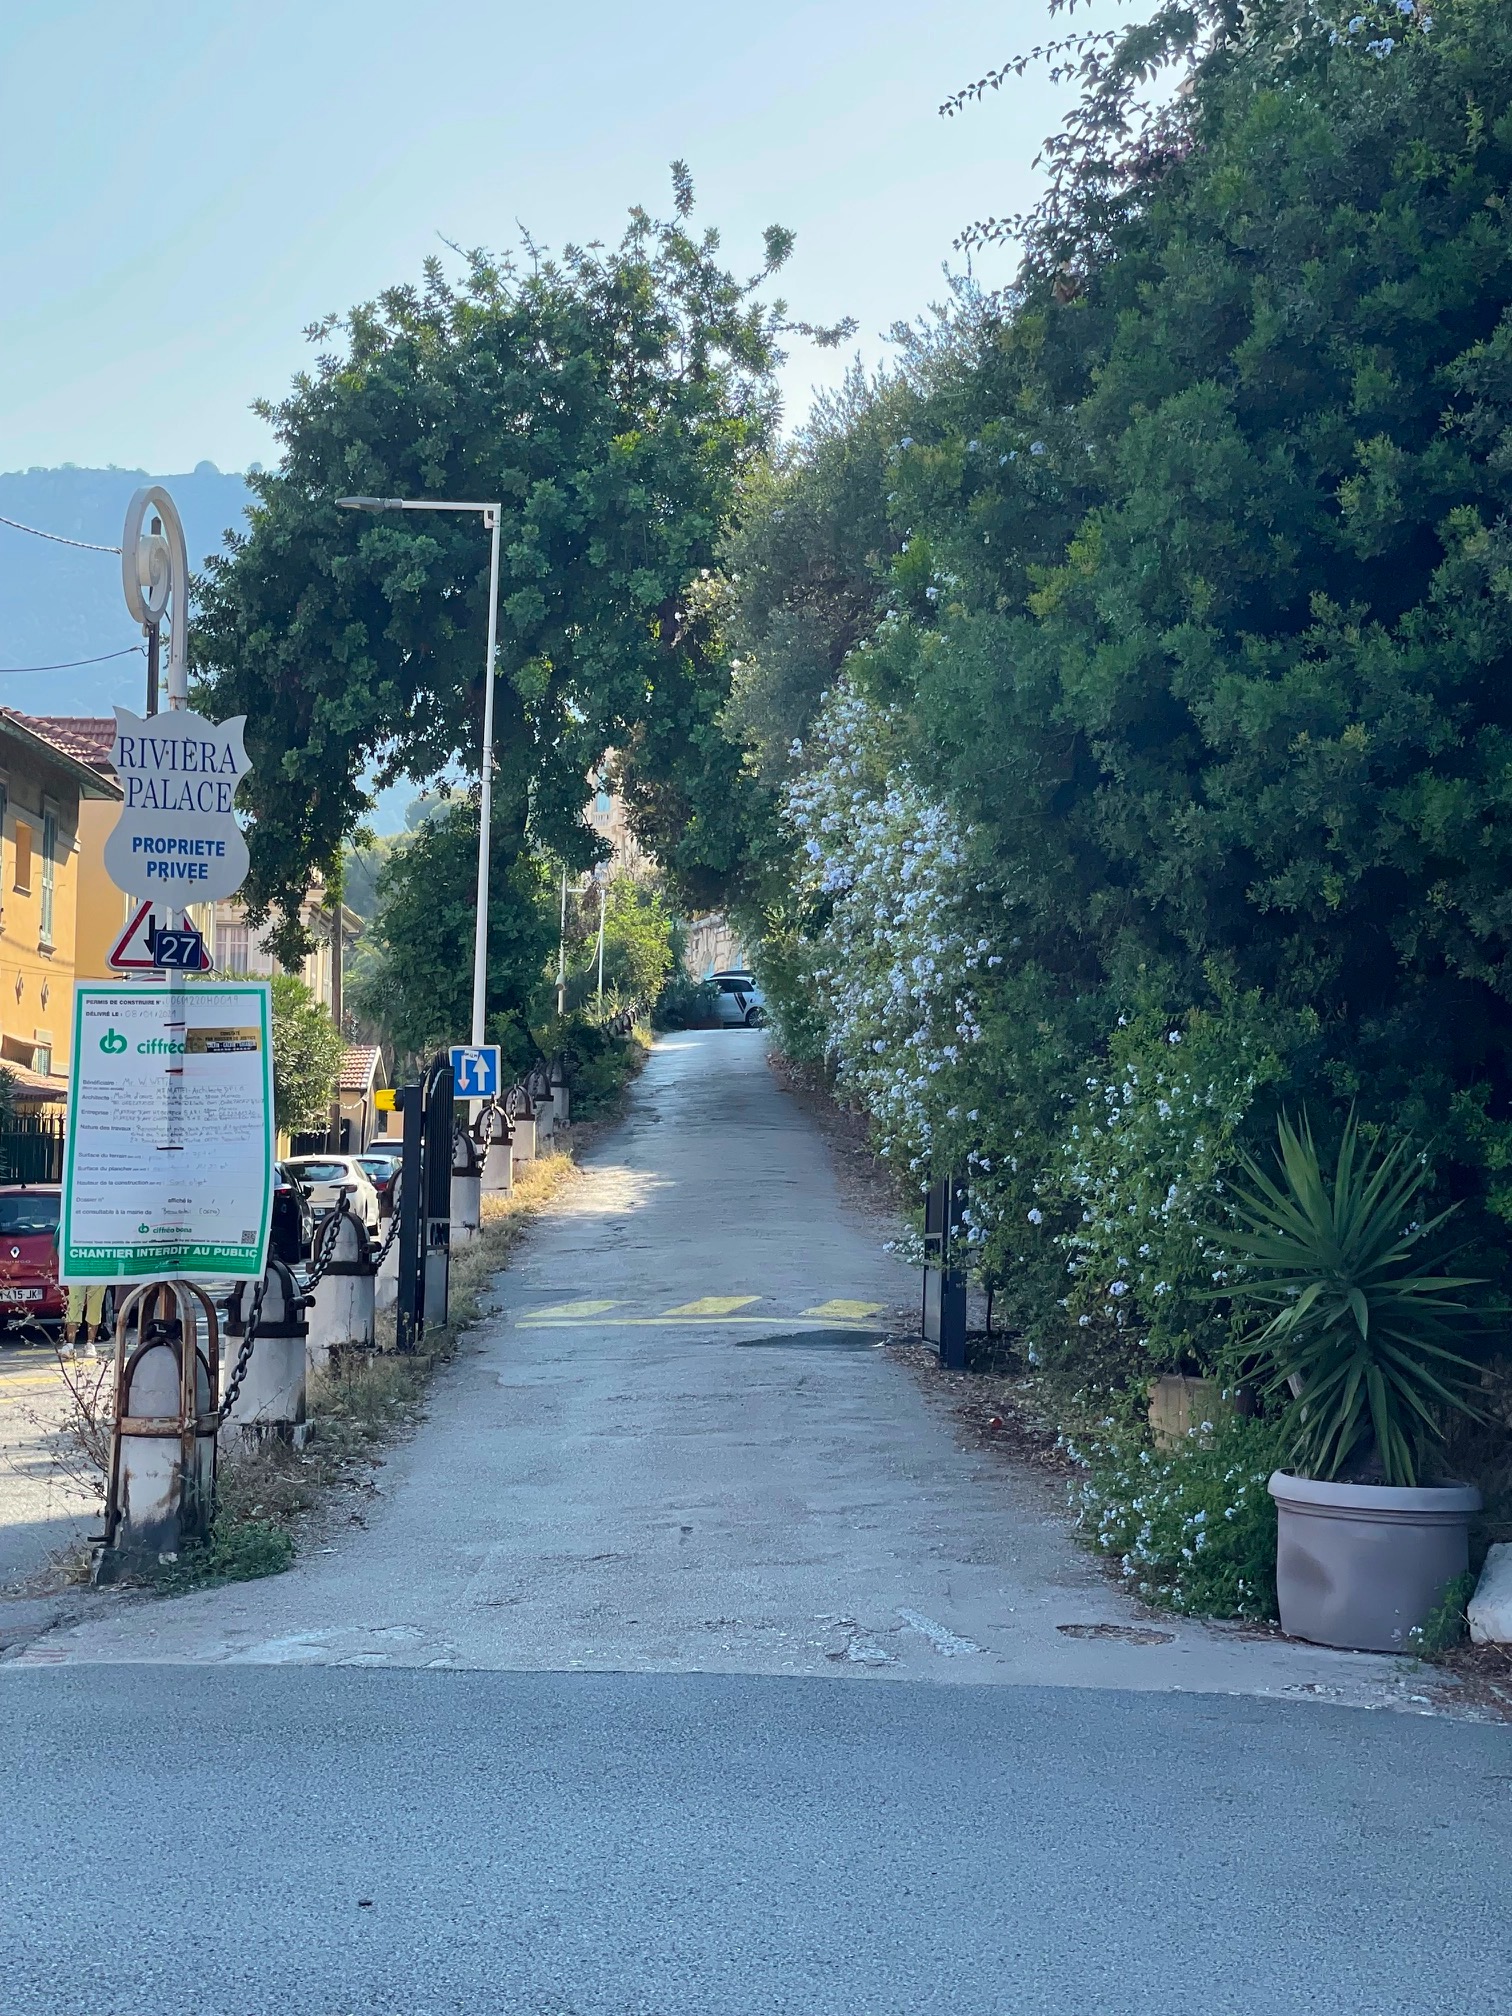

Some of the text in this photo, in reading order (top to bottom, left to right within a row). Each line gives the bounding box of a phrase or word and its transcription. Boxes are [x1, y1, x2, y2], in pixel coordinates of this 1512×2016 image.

[118, 736, 238, 774] RIVIÈRA
[126, 776, 232, 813] PALACE
[132, 836, 225, 857] PROPRIETE
[147, 861, 208, 880] PRIVEE
[161, 936, 197, 964] 27
[69, 1246, 258, 1258] CHANTIER INTERDIT AU PUBLIC
